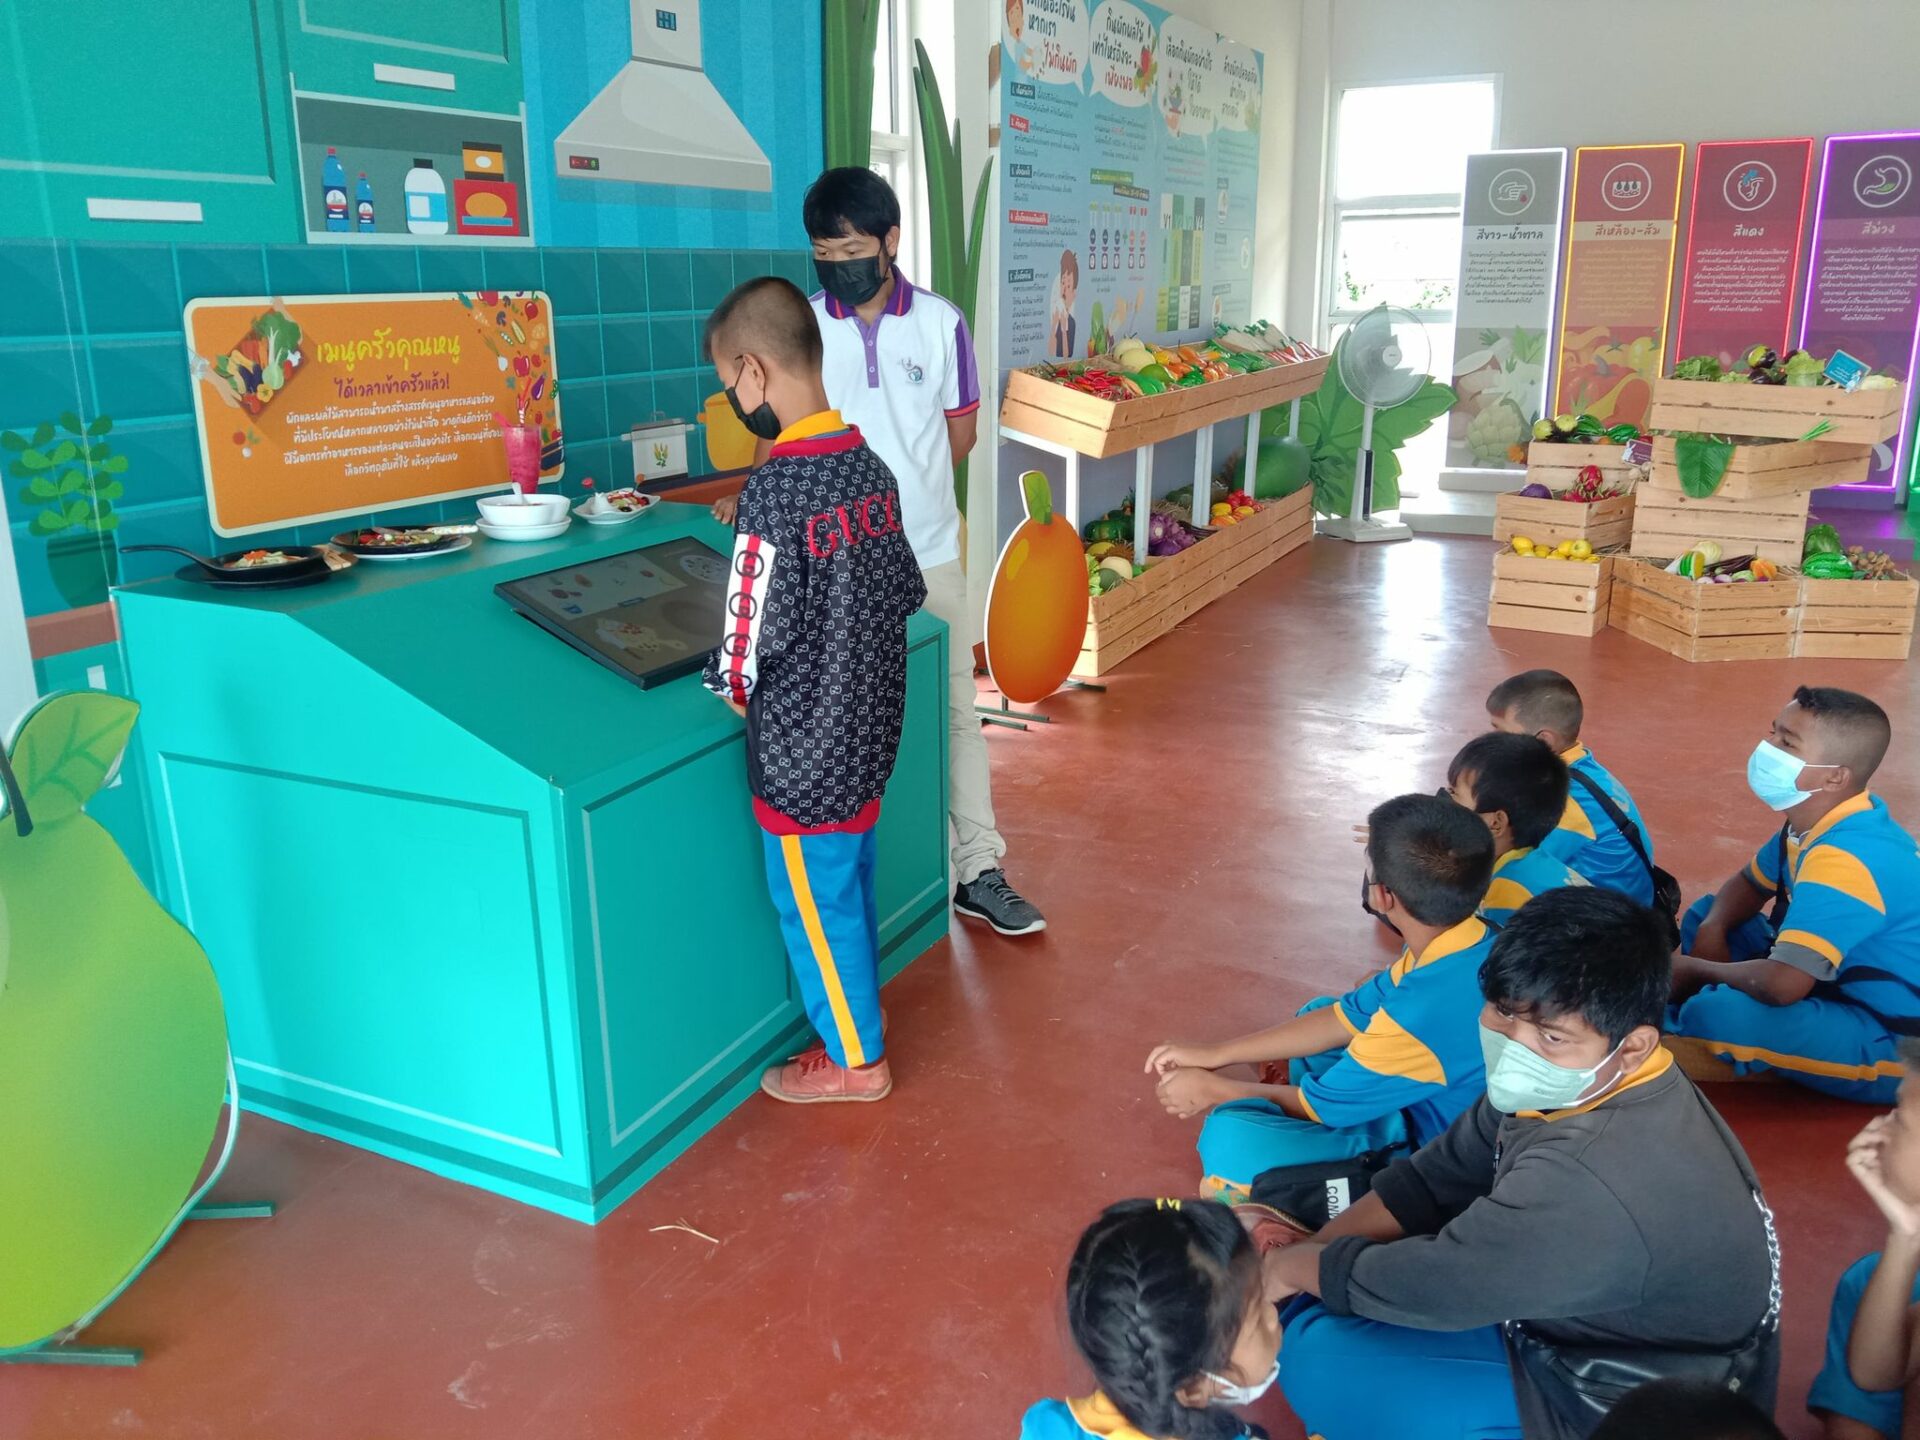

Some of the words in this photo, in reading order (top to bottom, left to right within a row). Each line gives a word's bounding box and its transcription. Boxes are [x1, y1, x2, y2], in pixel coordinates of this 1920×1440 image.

[1043, 38, 1077, 73] ไม่กินผัก
[1476, 222, 1543, 240] สีขาว-น้ำตาล
[1595, 222, 1661, 236] สีเหลือง-ส้ม
[1733, 223, 1764, 237] สีแดง
[1861, 221, 1896, 235] สีม่วง
[316, 326, 461, 372] เมนูครัวคุณหนู
[333, 371, 450, 399] ได้เวลาเข้าครัวแล้ว!
